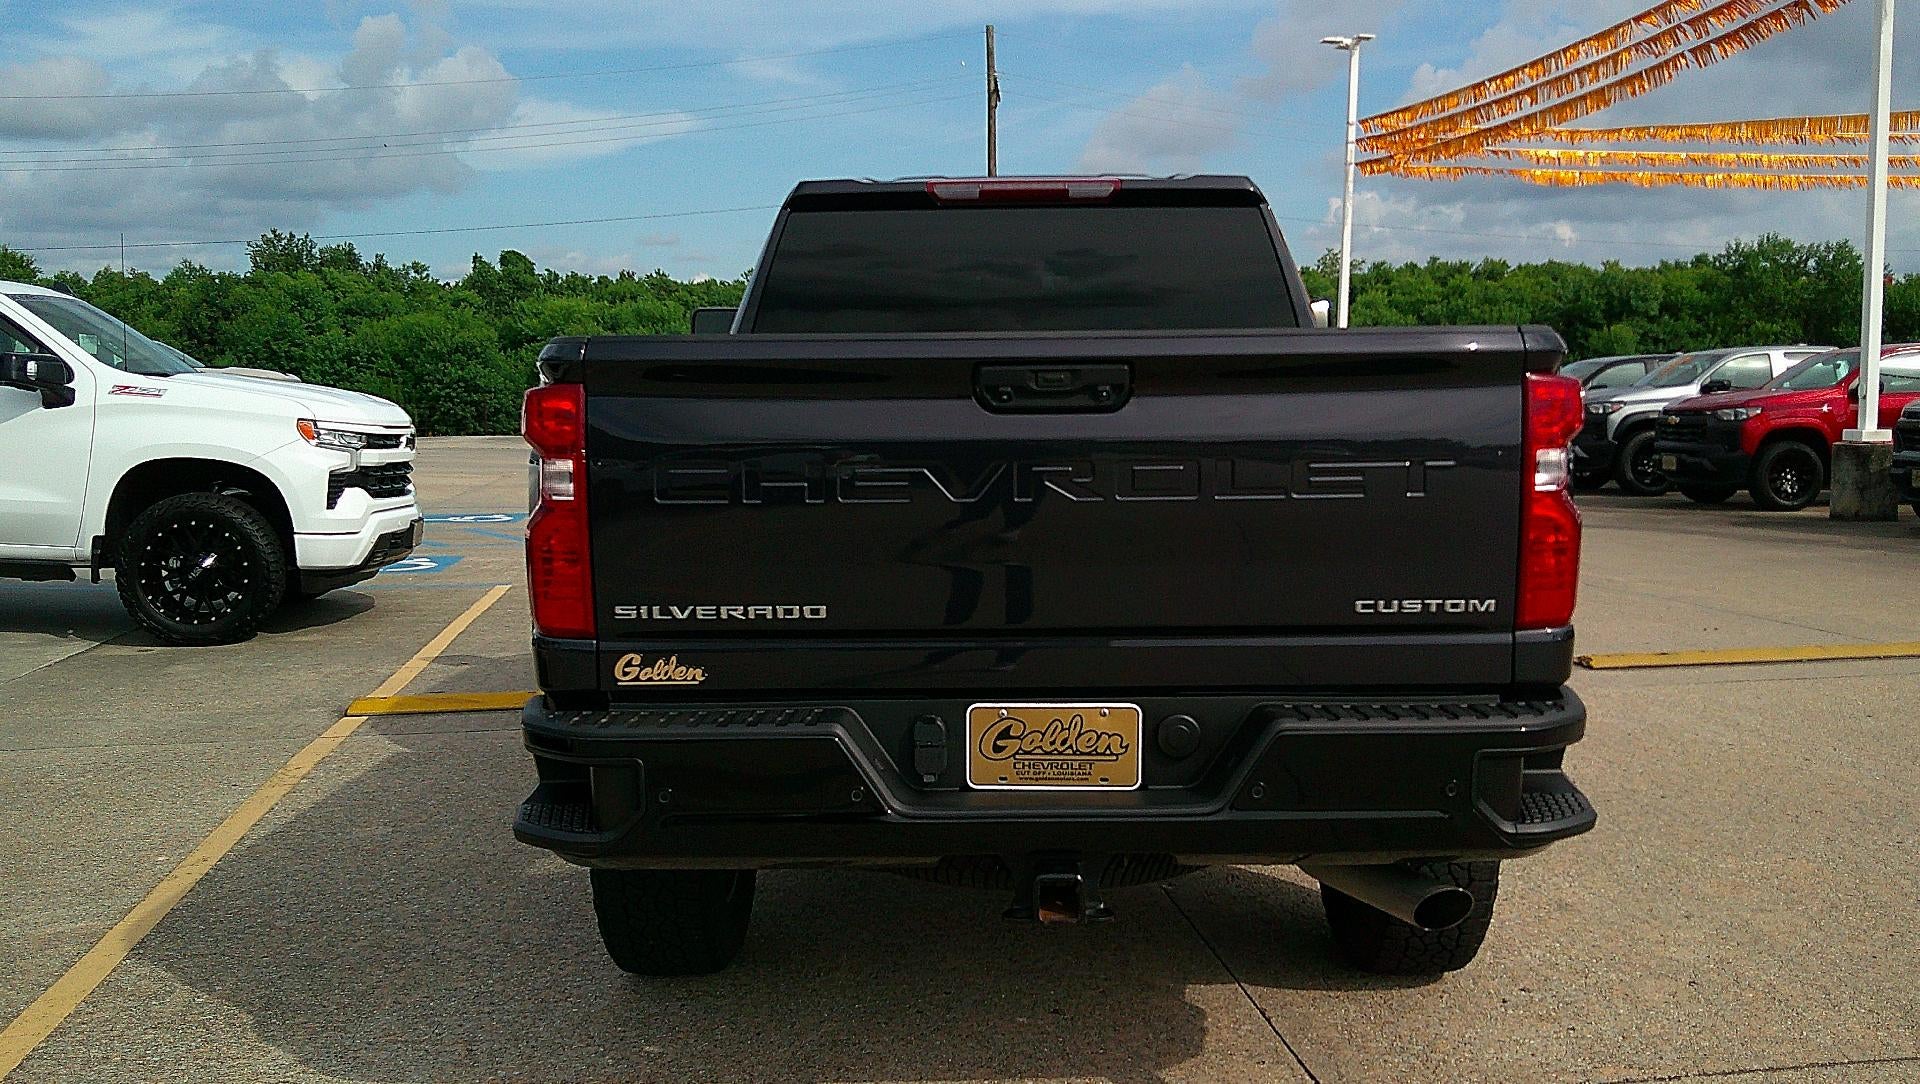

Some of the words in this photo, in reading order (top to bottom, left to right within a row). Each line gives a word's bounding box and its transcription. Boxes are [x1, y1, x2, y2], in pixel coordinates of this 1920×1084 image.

[653, 460, 1457, 503] CHEVROLET
[613, 605, 828, 619] SILVERADO
[1354, 599, 1496, 613] CUSTOM
[613, 653, 707, 682] Golden
[978, 714, 1130, 761] Golden
[1012, 761, 1095, 770] CHEVROLET
